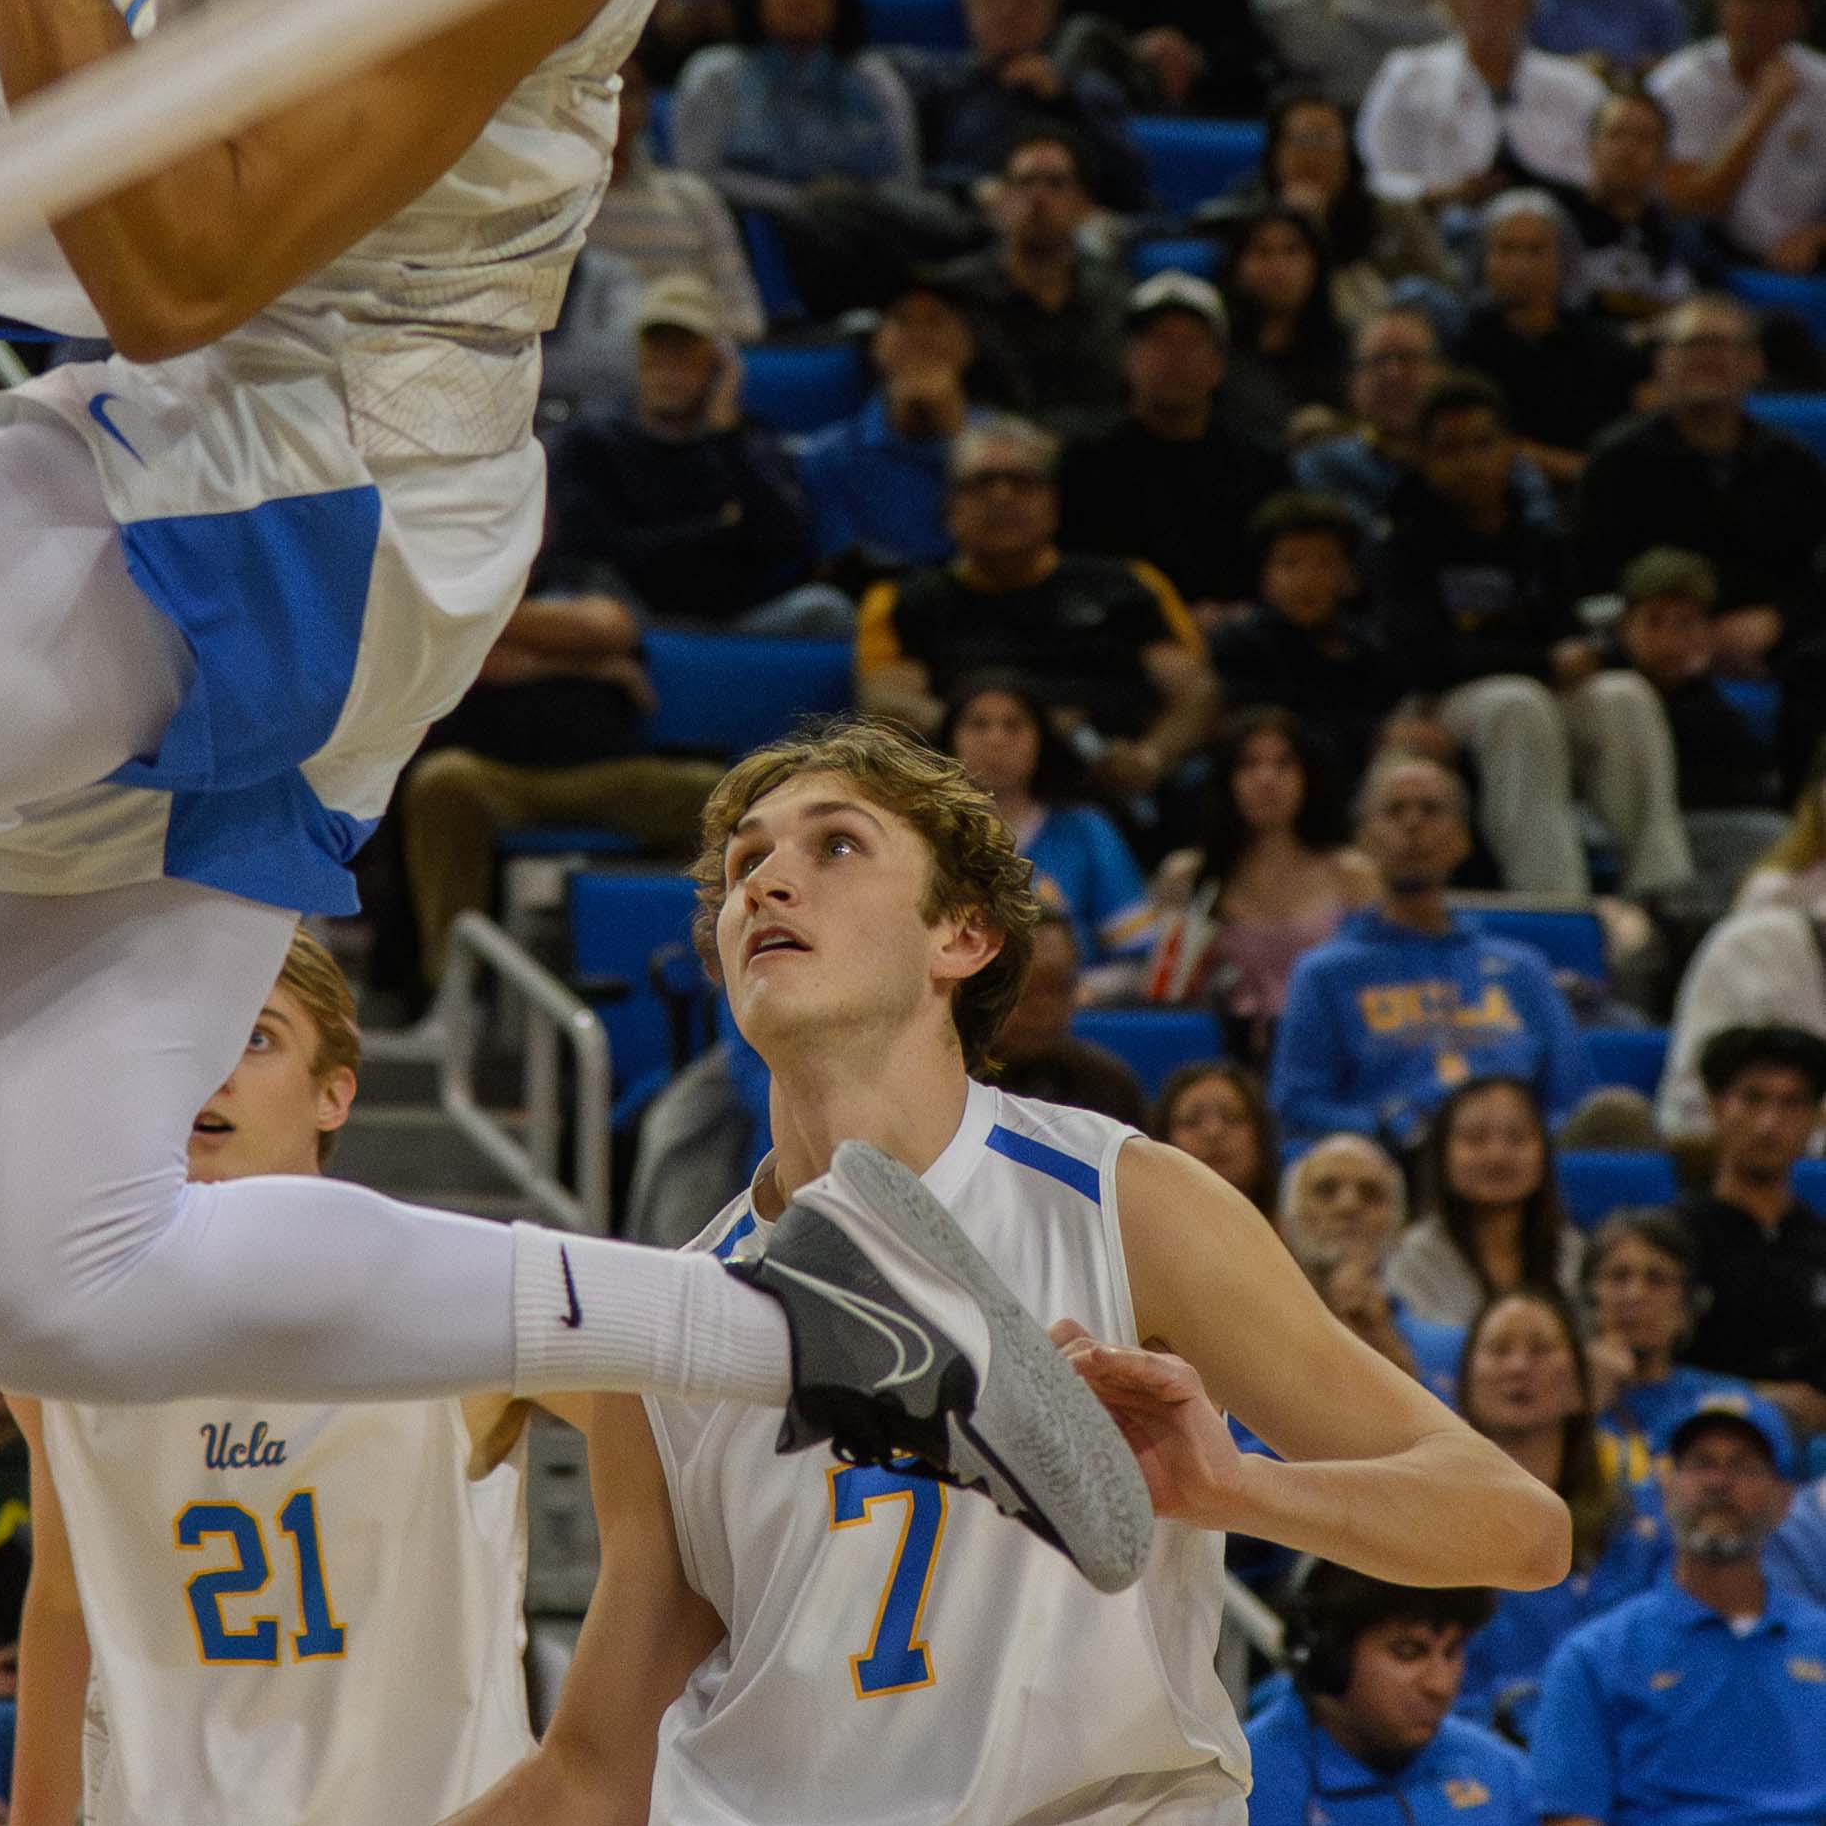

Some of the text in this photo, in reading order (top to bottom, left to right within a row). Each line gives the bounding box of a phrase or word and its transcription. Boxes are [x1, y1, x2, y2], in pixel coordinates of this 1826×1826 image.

[200, 1420, 286, 1471] Ucla
[172, 1486, 348, 1667] 21
[826, 1450, 948, 1700] 7
